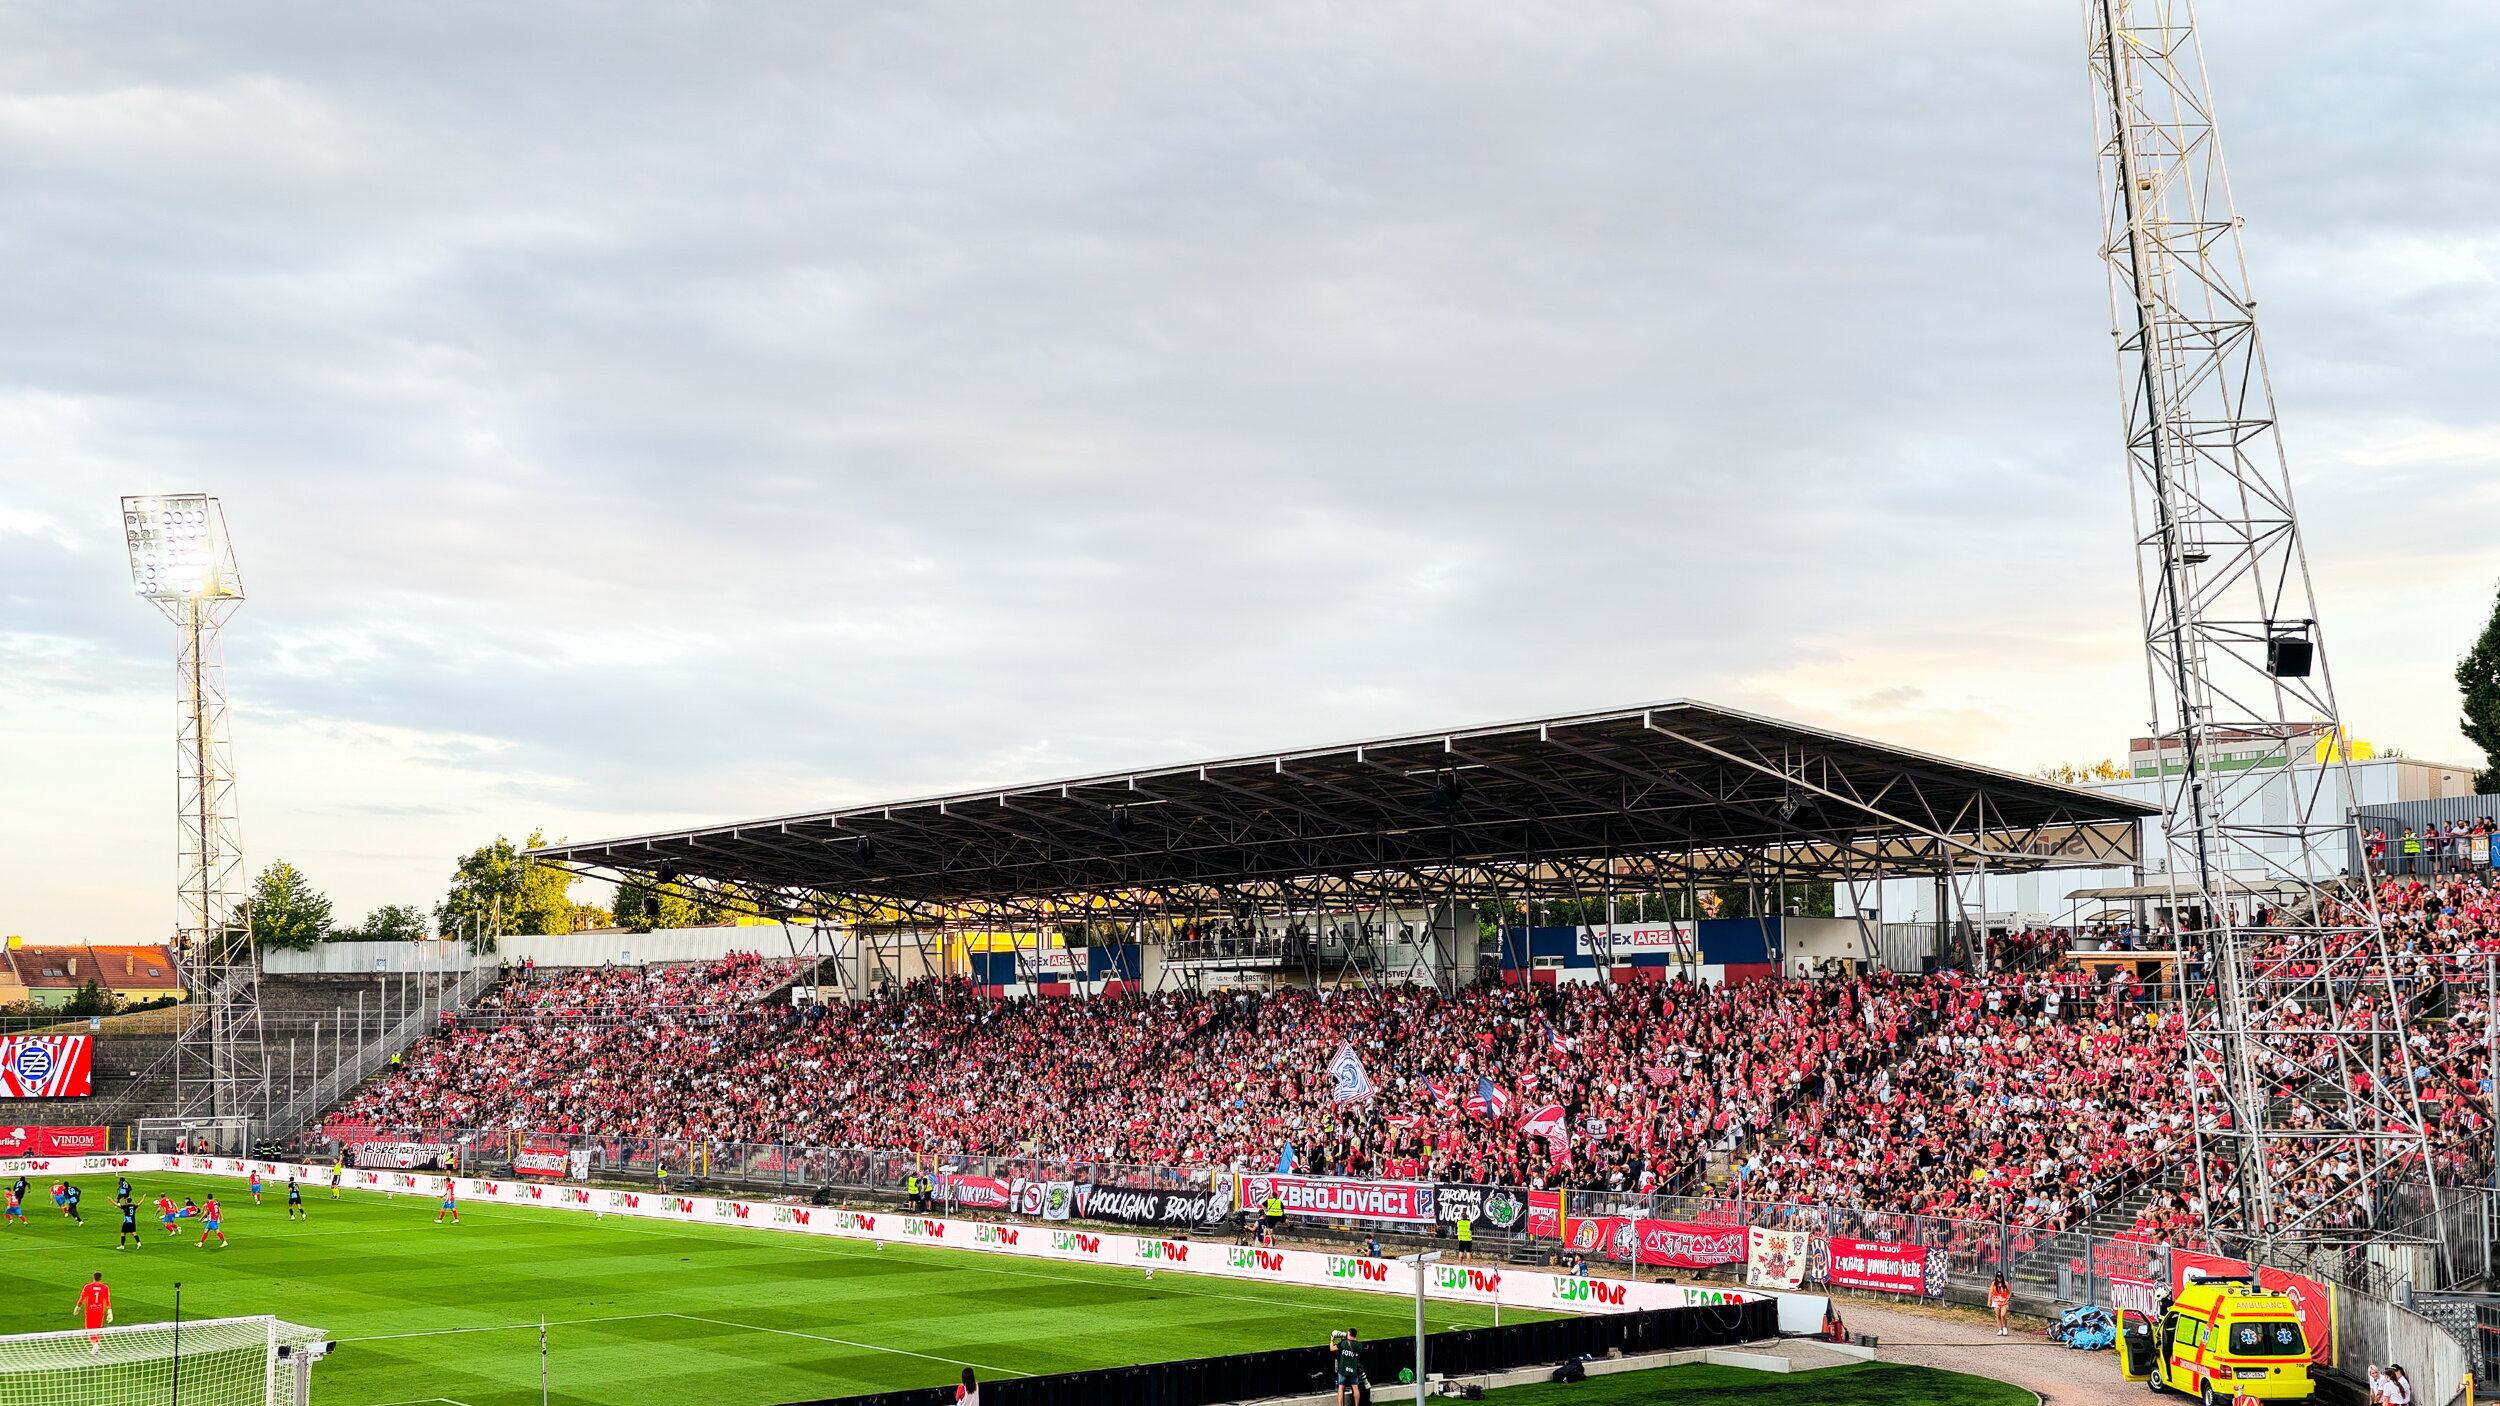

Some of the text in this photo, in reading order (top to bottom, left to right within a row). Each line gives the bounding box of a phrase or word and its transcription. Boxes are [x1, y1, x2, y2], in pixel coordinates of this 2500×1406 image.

[51, 1135, 94, 1147] VINDOM
[1087, 1187, 1158, 1221] HOOLIGANS
[1277, 1185, 1408, 1215] ZBROJOVÁCI
[1645, 1229, 1744, 1261] ORTHODOX
